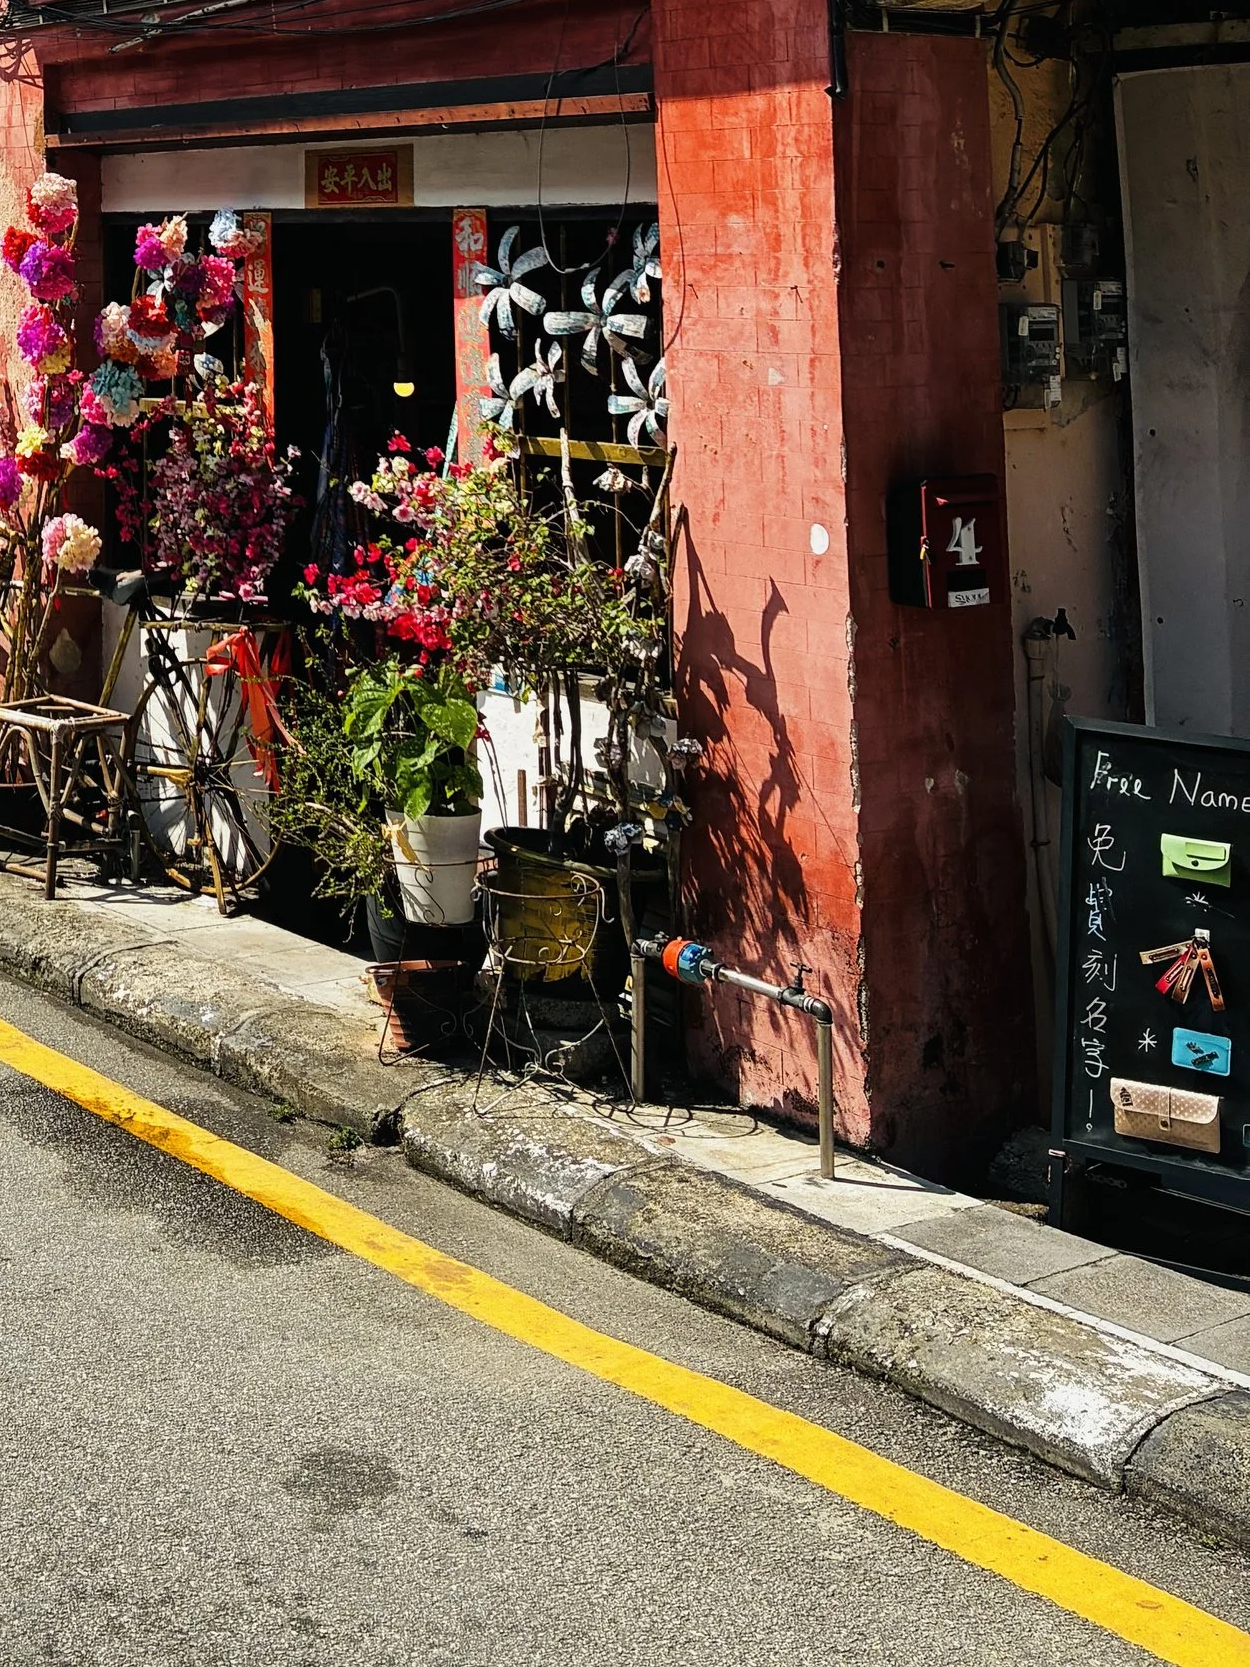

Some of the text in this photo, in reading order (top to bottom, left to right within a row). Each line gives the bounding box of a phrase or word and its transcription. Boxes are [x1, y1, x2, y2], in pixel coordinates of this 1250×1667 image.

[945, 516, 983, 566] 4
[1089, 750, 1250, 813] Free Name
